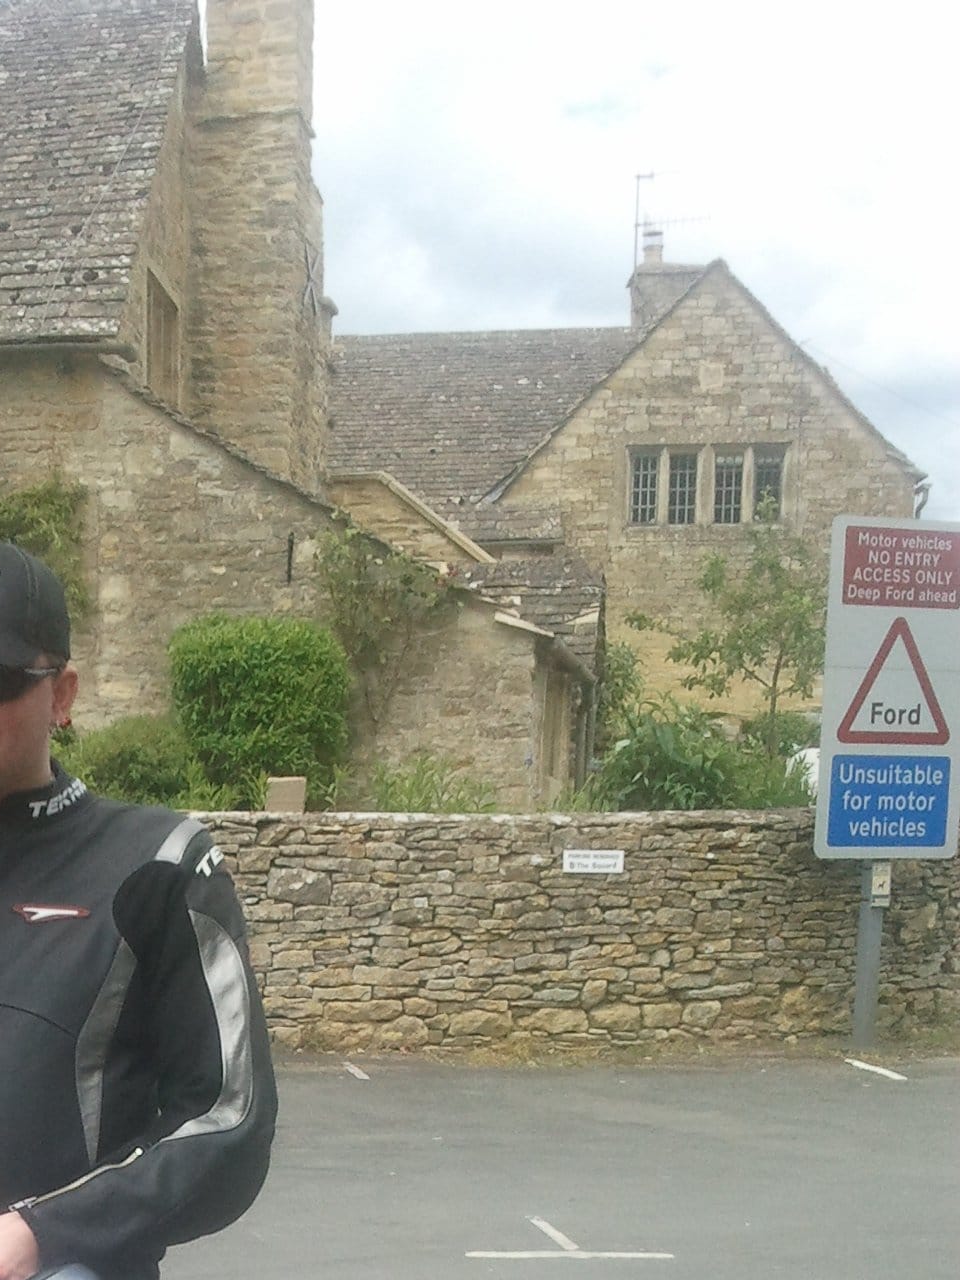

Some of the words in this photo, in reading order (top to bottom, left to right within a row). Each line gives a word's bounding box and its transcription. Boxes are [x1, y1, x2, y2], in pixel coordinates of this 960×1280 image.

[858, 532, 897, 548] Motor
[902, 536, 952, 551] vehicles
[868, 551, 890, 565] NO
[895, 552, 940, 567] ENTRY
[853, 567, 910, 583] ACCESS
[915, 570, 953, 585] ONLY
[848, 584, 880, 601] Deep
[885, 587, 915, 600] Ford
[918, 590, 957, 603] ahead
[870, 702, 921, 725] Ford
[839, 763, 944, 785] Unsuitable
[842, 790, 871, 811] for
[877, 791, 936, 811] motor
[848, 817, 926, 837] vehicles
